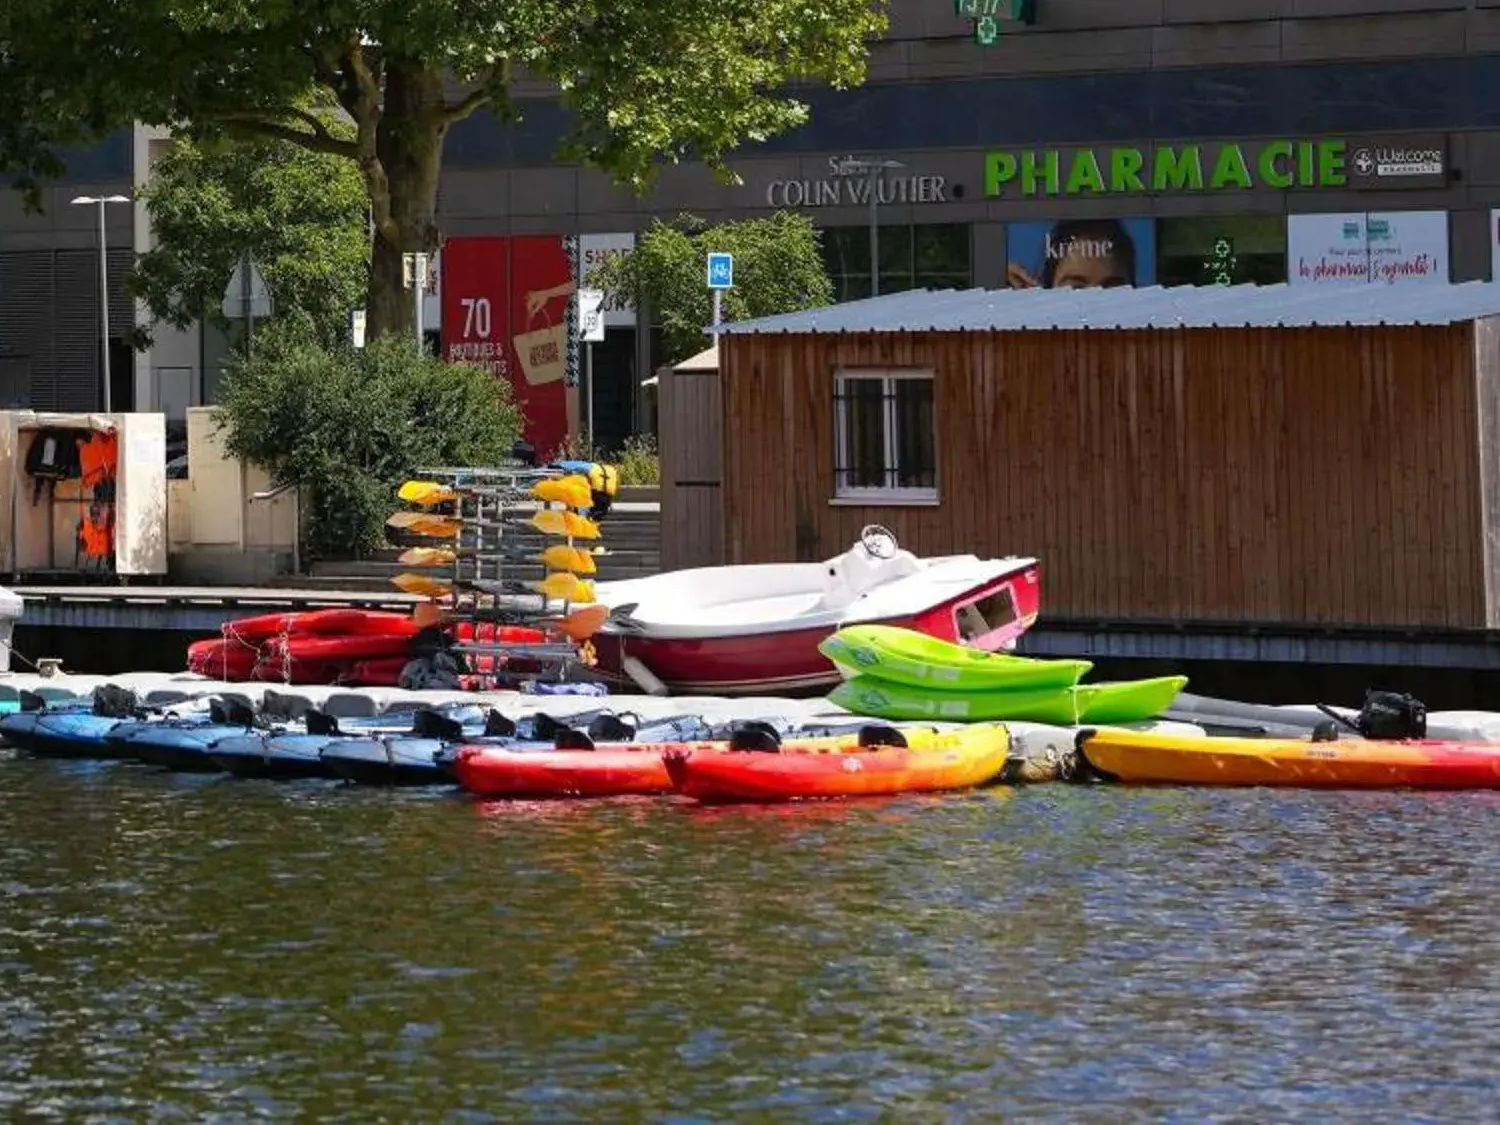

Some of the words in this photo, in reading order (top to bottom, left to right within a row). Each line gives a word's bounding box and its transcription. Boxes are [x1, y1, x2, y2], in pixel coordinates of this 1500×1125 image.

[985, 141, 1347, 196] PHARMACIE
[767, 179, 841, 207] COLIN
[847, 175, 947, 204] VAUTIER
[1045, 234, 1113, 258] krème
[461, 298, 491, 338] 70
